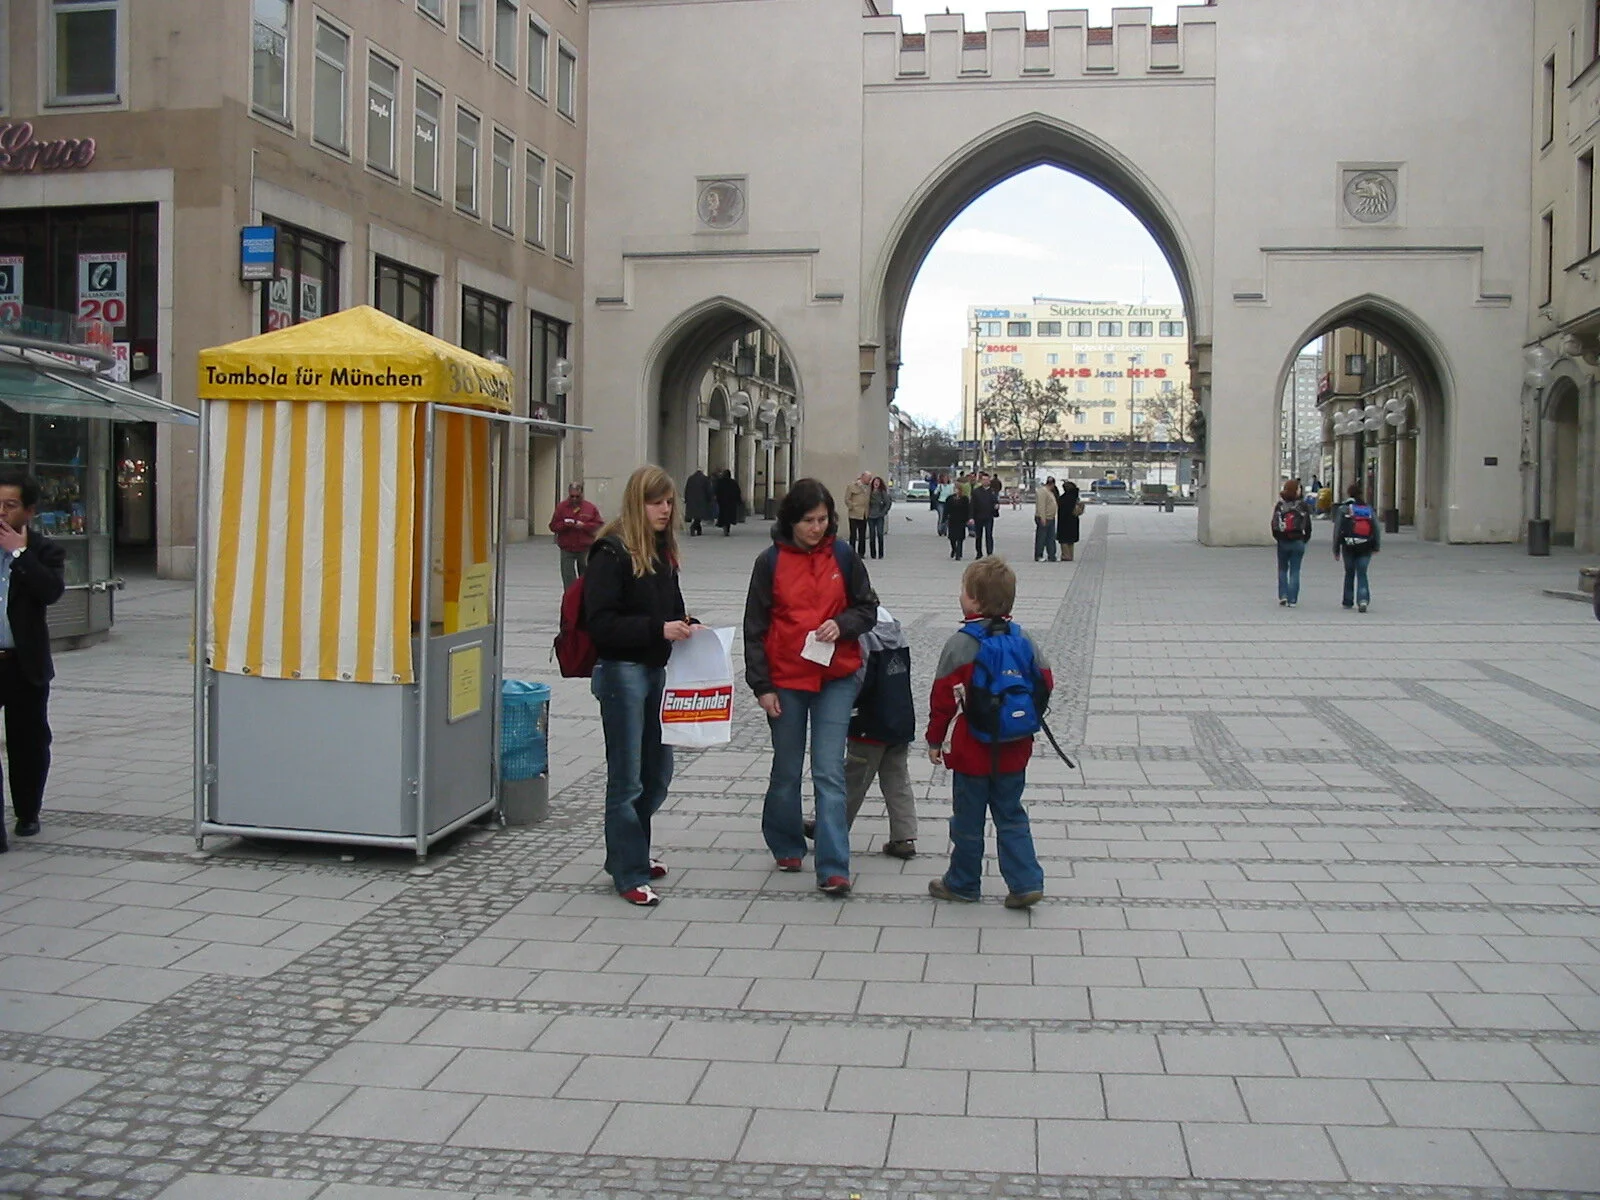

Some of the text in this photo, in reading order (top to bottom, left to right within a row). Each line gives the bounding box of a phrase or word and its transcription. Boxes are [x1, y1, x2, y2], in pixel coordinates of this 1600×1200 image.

[79, 298, 125, 323] 20
[1049, 304, 1172, 320] Süddeutsche Zeitung
[986, 344, 1018, 353] BOSCH
[206, 365, 423, 387] Tombola für München
[1094, 367, 1123, 379] Jeans
